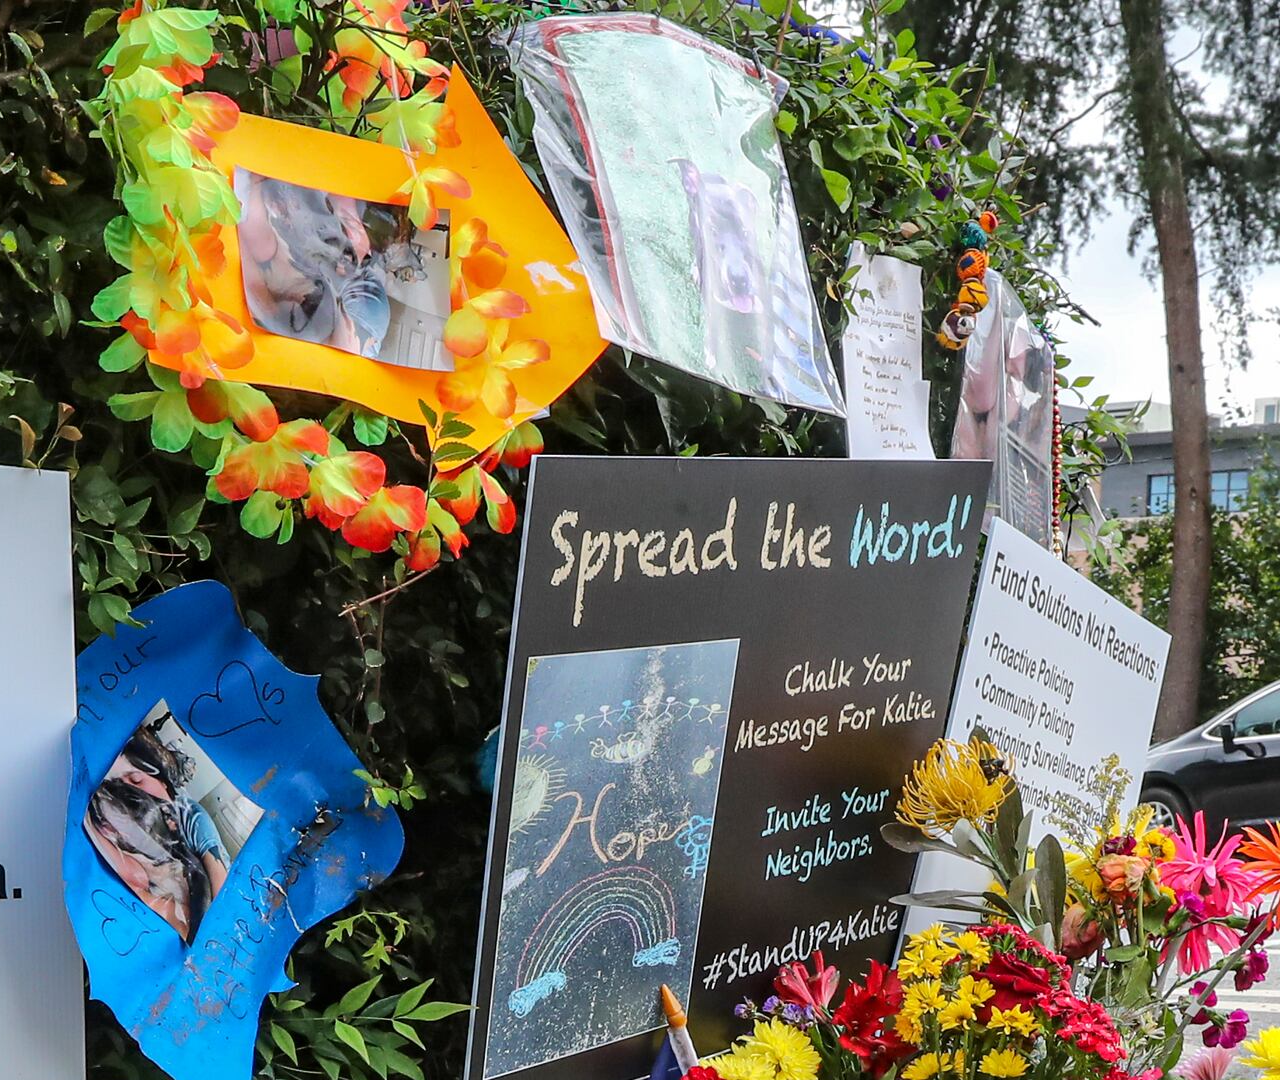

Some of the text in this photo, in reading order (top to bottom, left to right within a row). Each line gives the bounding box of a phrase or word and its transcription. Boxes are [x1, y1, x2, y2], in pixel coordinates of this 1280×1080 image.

[550, 496, 738, 627] Spread
[760, 500, 832, 571] the
[849, 494, 972, 569] Word!
[990, 551, 1160, 684] Fund Solutions Not Reactions:
[99, 635, 157, 691] our
[785, 653, 912, 697] Chalk Your
[989, 632, 1074, 705] Proactive Policing
[734, 691, 936, 753] Message For Katie.
[981, 673, 1074, 746] Community Policing
[1017, 777, 1051, 811] iminals
[1031, 741, 1086, 786] Surveillance
[535, 782, 689, 878] Hope
[761, 786, 890, 837] Invite Your
[765, 830, 873, 883] Neighbors.
[703, 904, 899, 991] #StandUP4Katie
